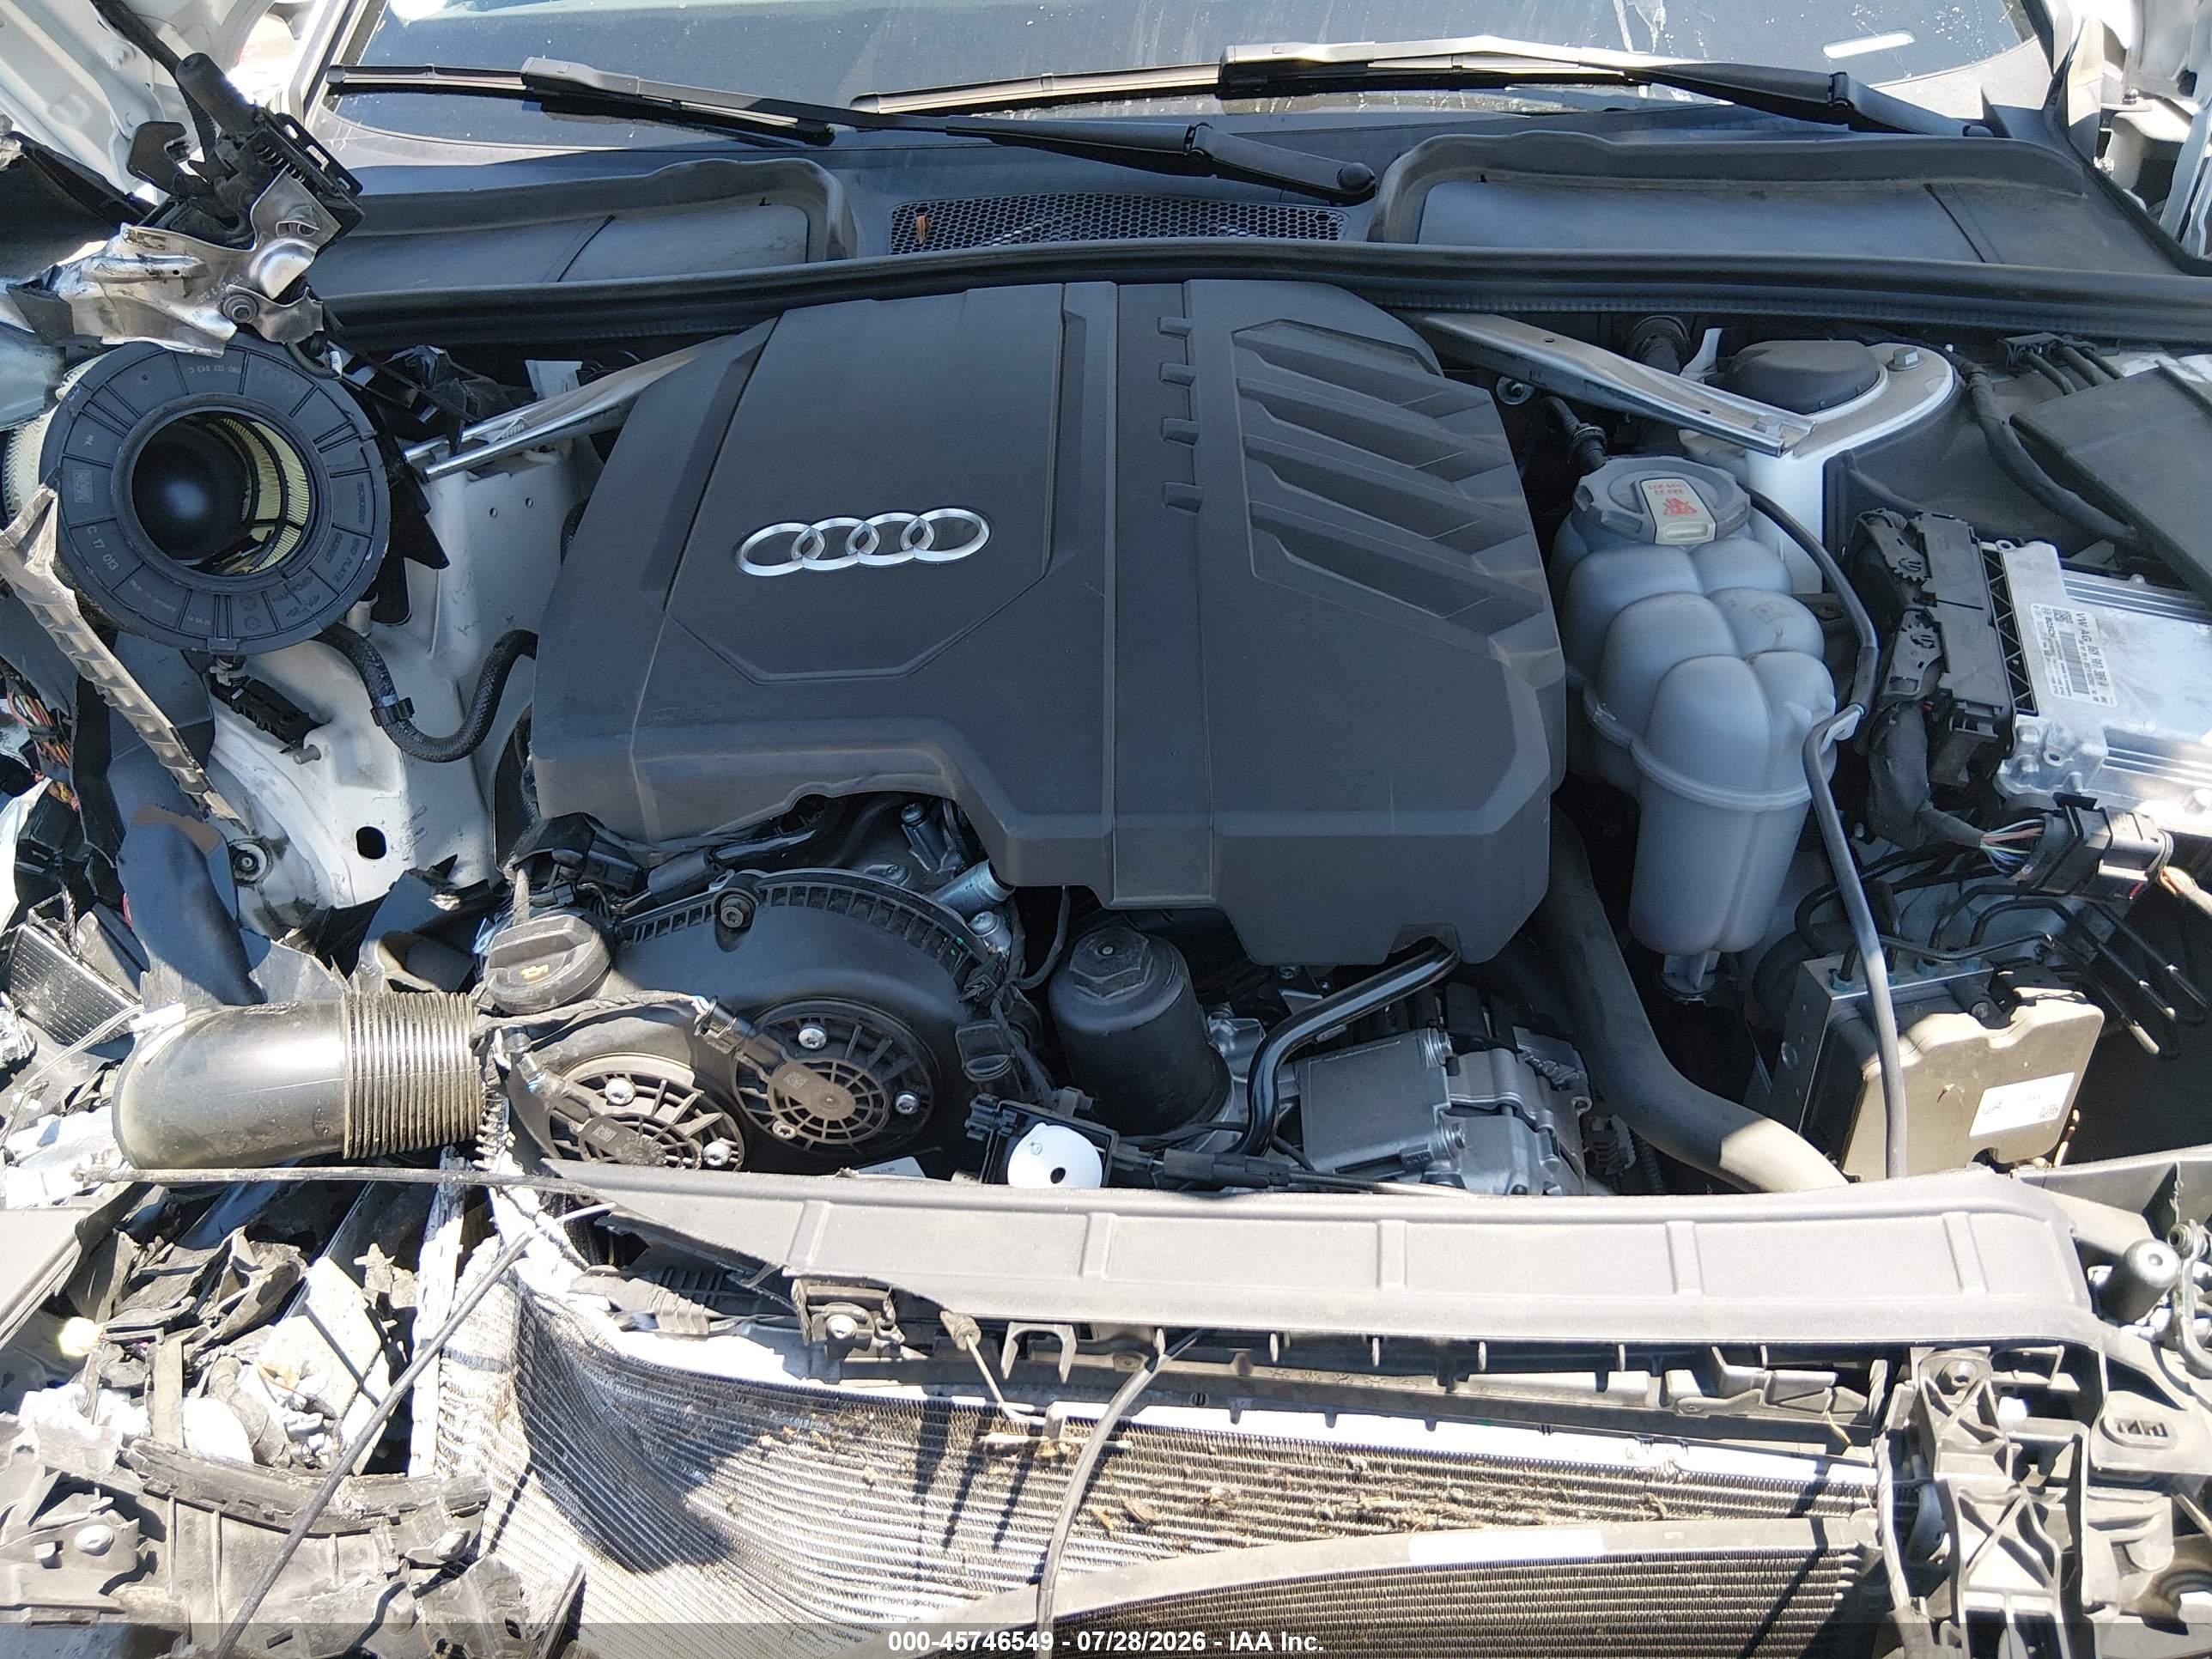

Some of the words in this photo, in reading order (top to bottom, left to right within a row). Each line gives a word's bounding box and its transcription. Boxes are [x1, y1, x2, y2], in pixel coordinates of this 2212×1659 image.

[88, 526, 98, 535] C
[93, 538, 105, 550] 17
[102, 554, 118, 570] 013
[2075, 612, 2088, 628] VW
[2081, 628, 2092, 642] AG
